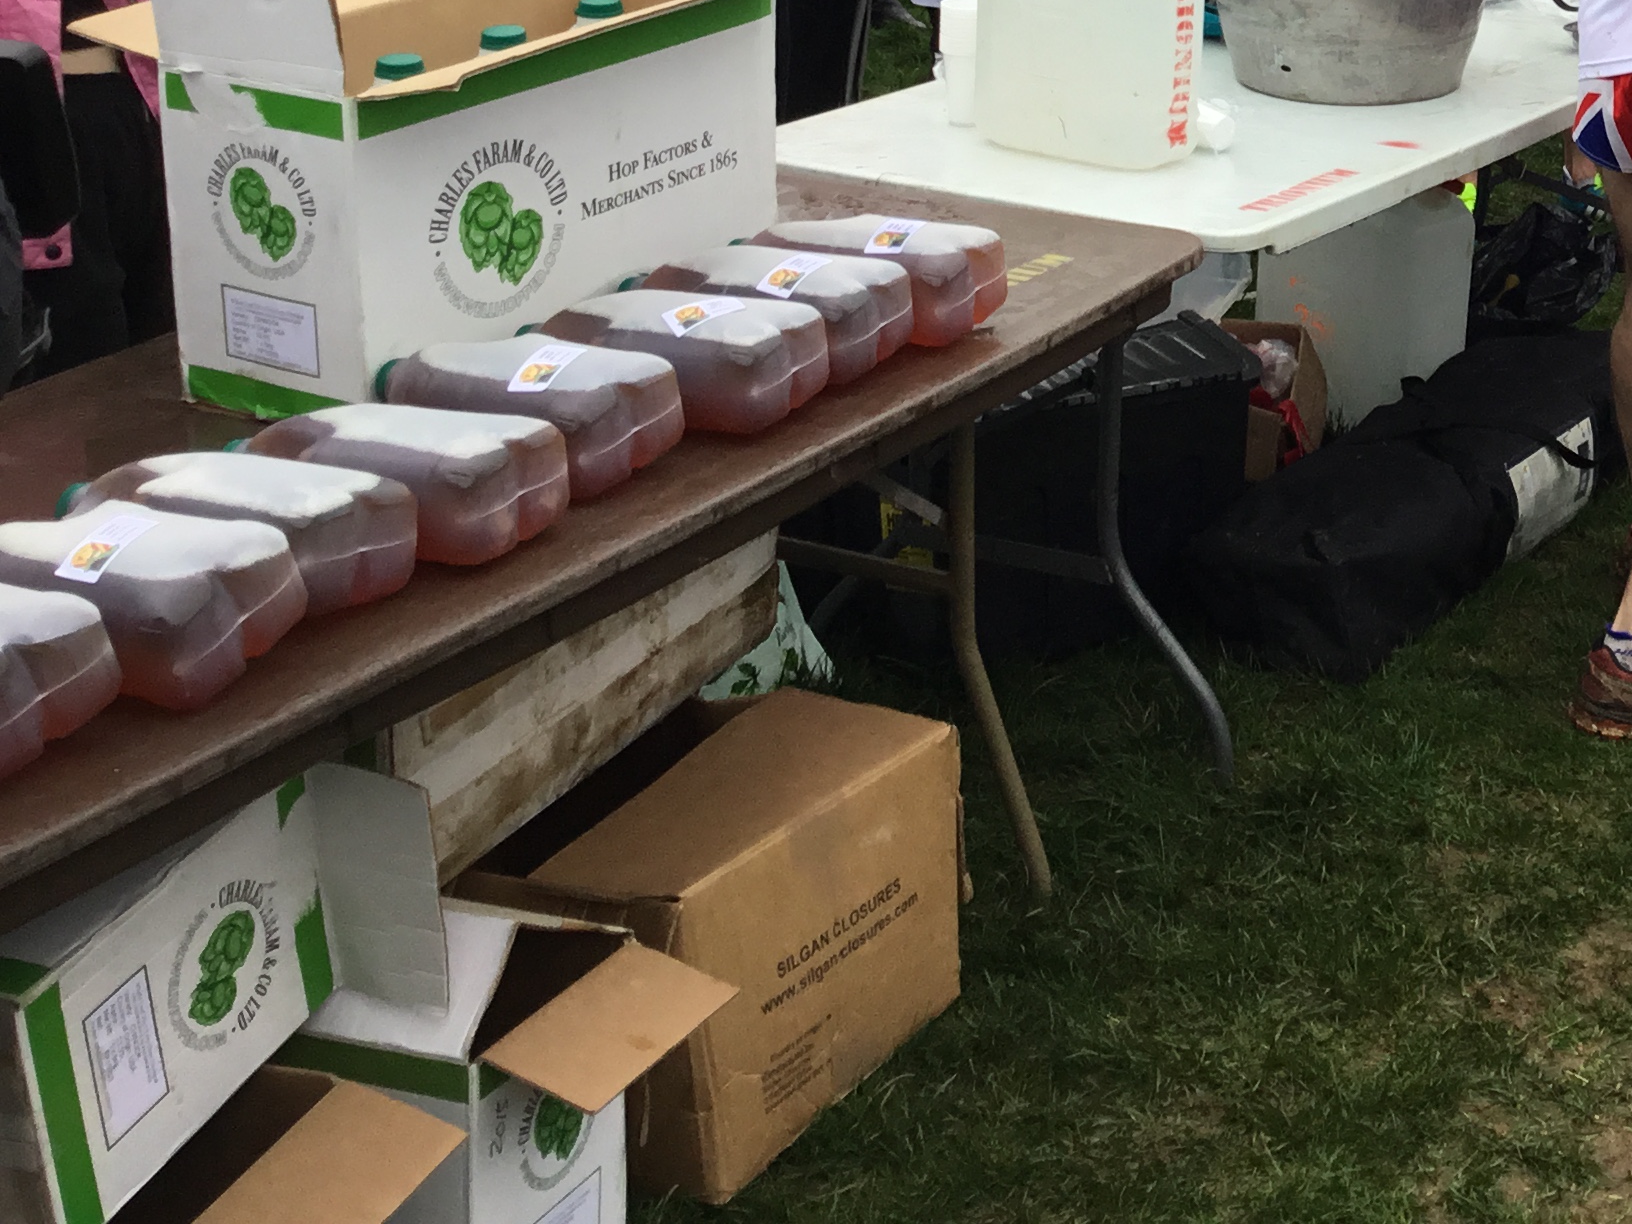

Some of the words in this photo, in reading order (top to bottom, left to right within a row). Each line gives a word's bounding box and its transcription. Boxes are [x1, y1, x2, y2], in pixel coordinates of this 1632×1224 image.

[701, 131, 714, 148] &
[207, 142, 242, 197] CHARLES
[279, 156, 290, 174] &
[287, 168, 305, 189] CO
[297, 188, 317, 218] LTD
[428, 161, 475, 244] CHARLES
[472, 138, 525, 174] FARAM
[523, 143, 536, 163] &
[534, 151, 555, 178] CO
[549, 170, 568, 208] LTD
[580, 178, 664, 221] MERCHANTS
[667, 162, 707, 187] SINCE
[709, 150, 738, 174] 1865
[1238, 168, 1361, 212] TRIONIUM
[760, 891, 919, 1015] www.silgan-closures.com
[776, 929, 831, 979] SILGAN
[832, 877, 902, 938] CLOSURES
[254, 973, 272, 997] CO
[262, 956, 278, 971] &
[237, 995, 262, 1031] LTD
